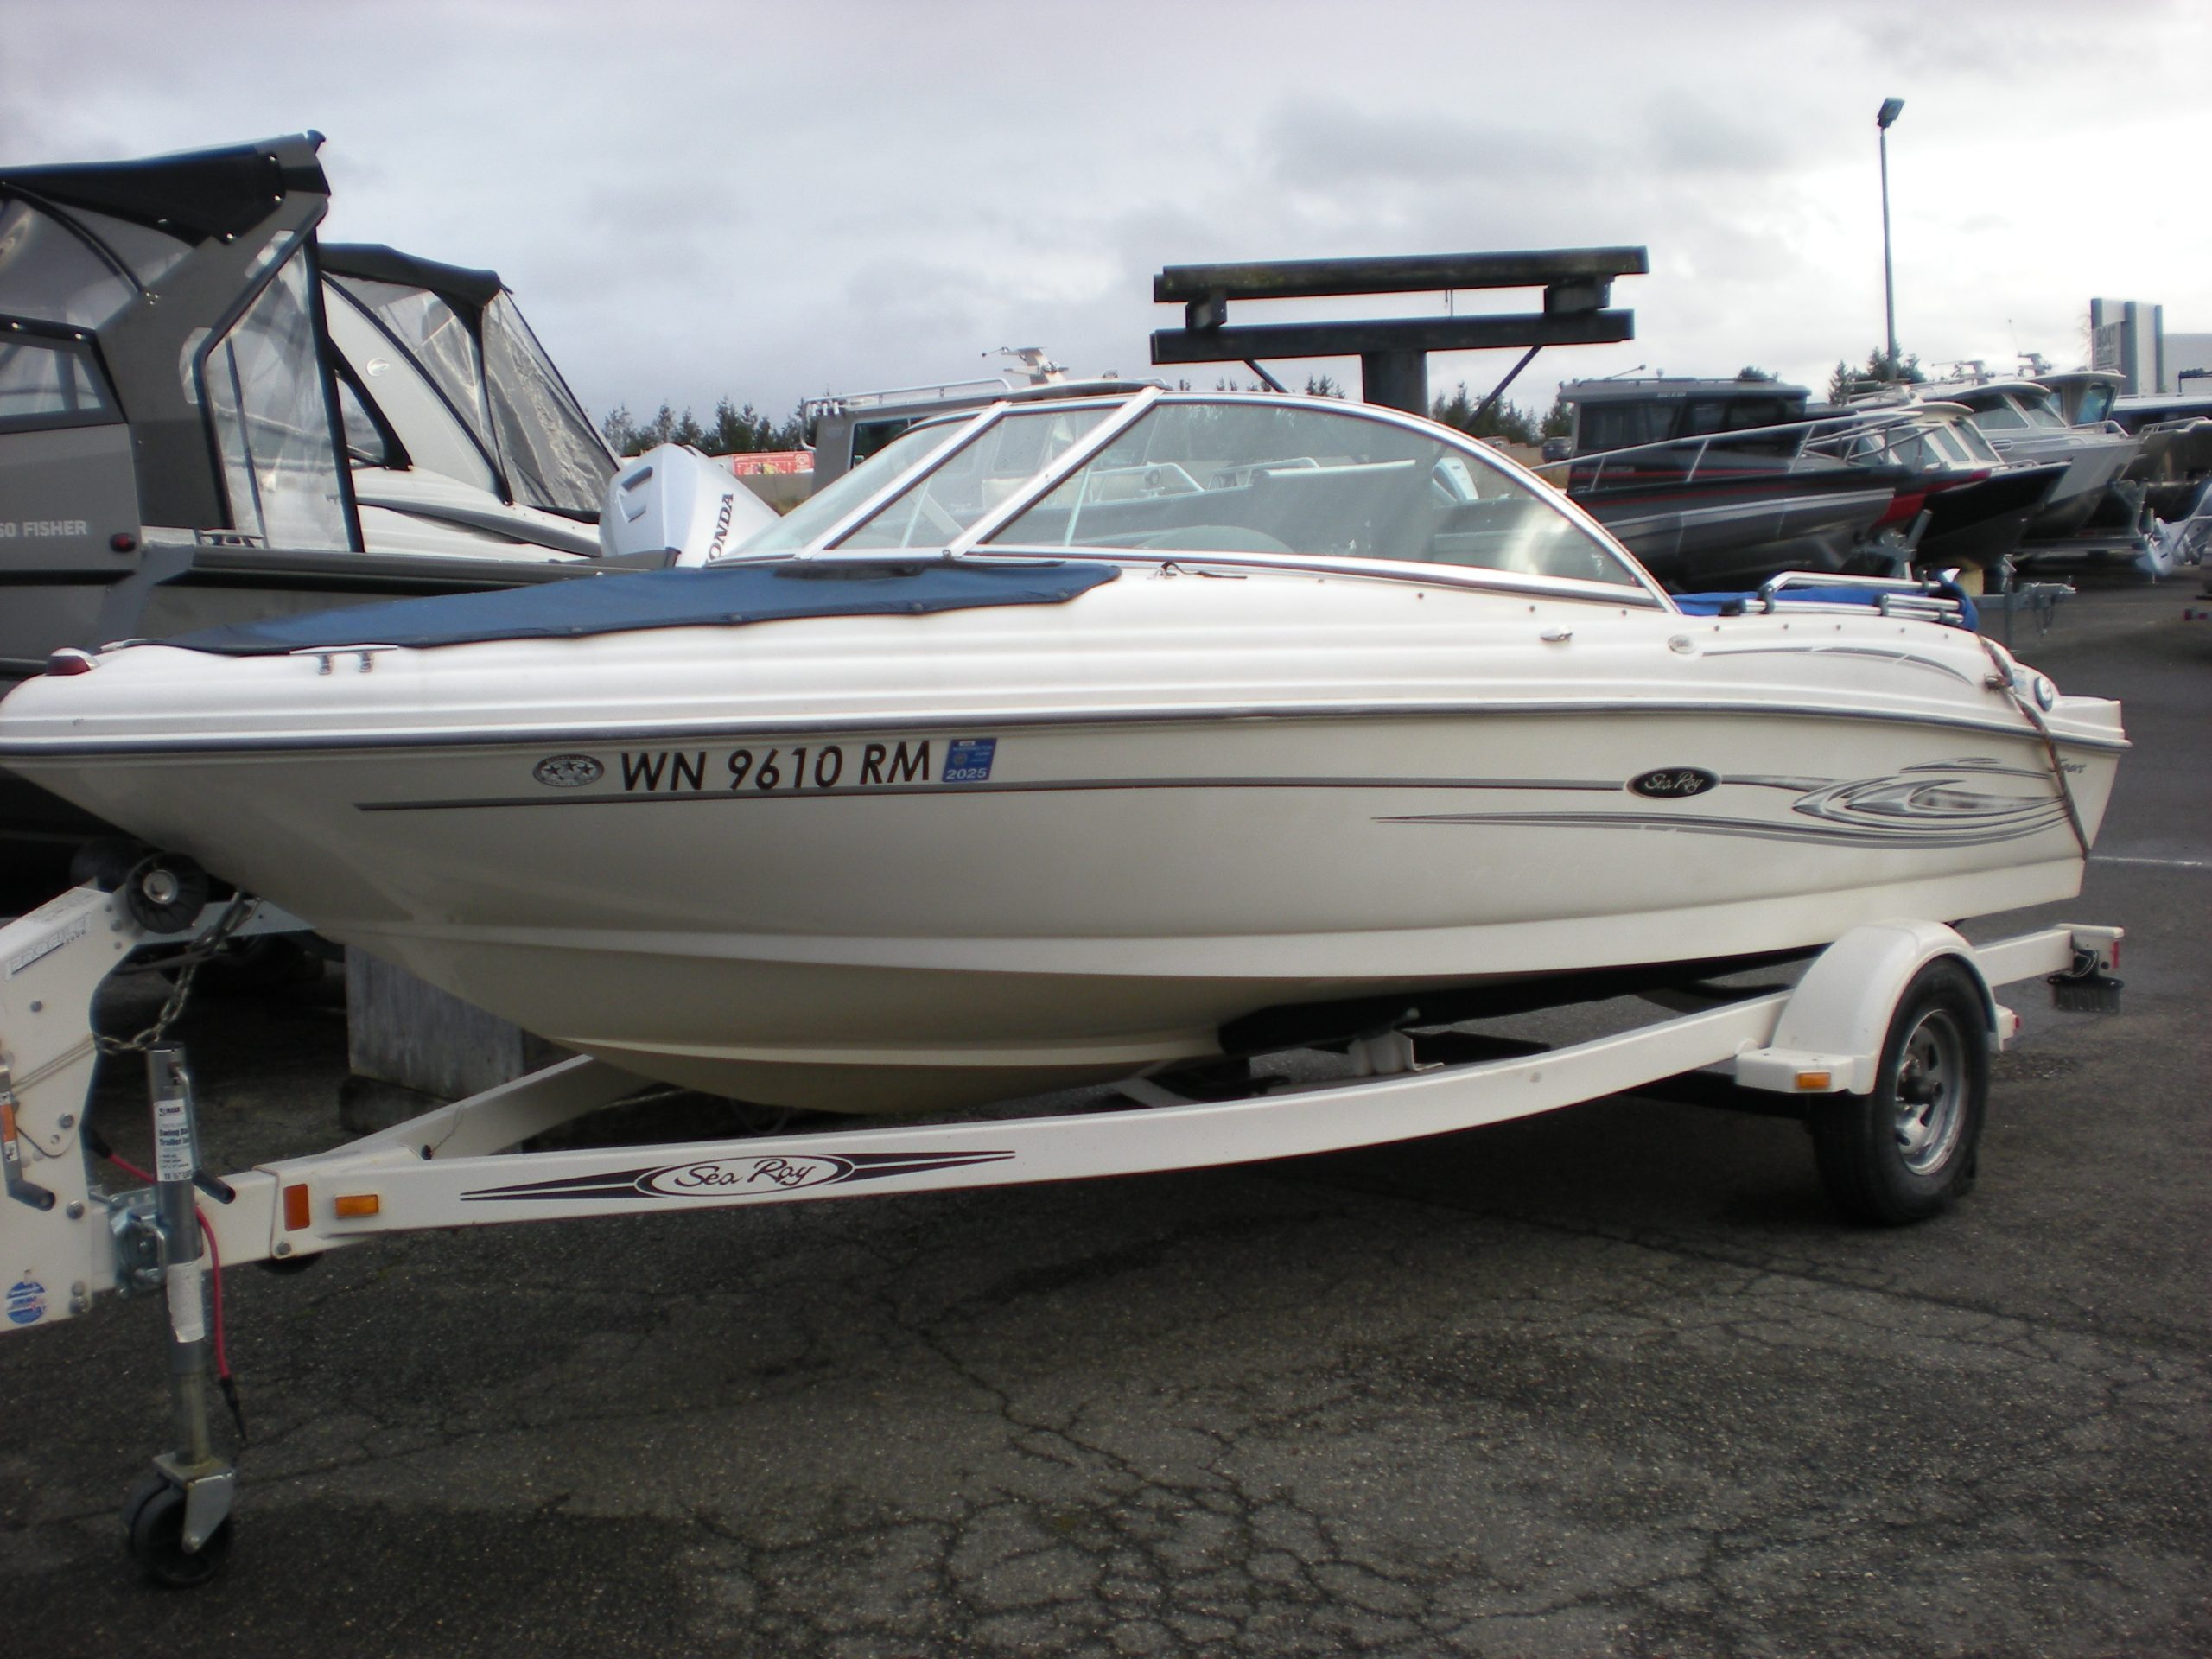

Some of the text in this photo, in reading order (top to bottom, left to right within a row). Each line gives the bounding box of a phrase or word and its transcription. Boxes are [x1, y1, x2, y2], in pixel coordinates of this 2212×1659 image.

[22, 520, 87, 536] FISHER
[705, 493, 734, 563] ONDA
[620, 740, 930, 791] WN 9610 RM
[946, 768, 987, 779] 2025
[1644, 771, 1704, 794] Sea Ray
[673, 1158, 817, 1188] Sea Ray
